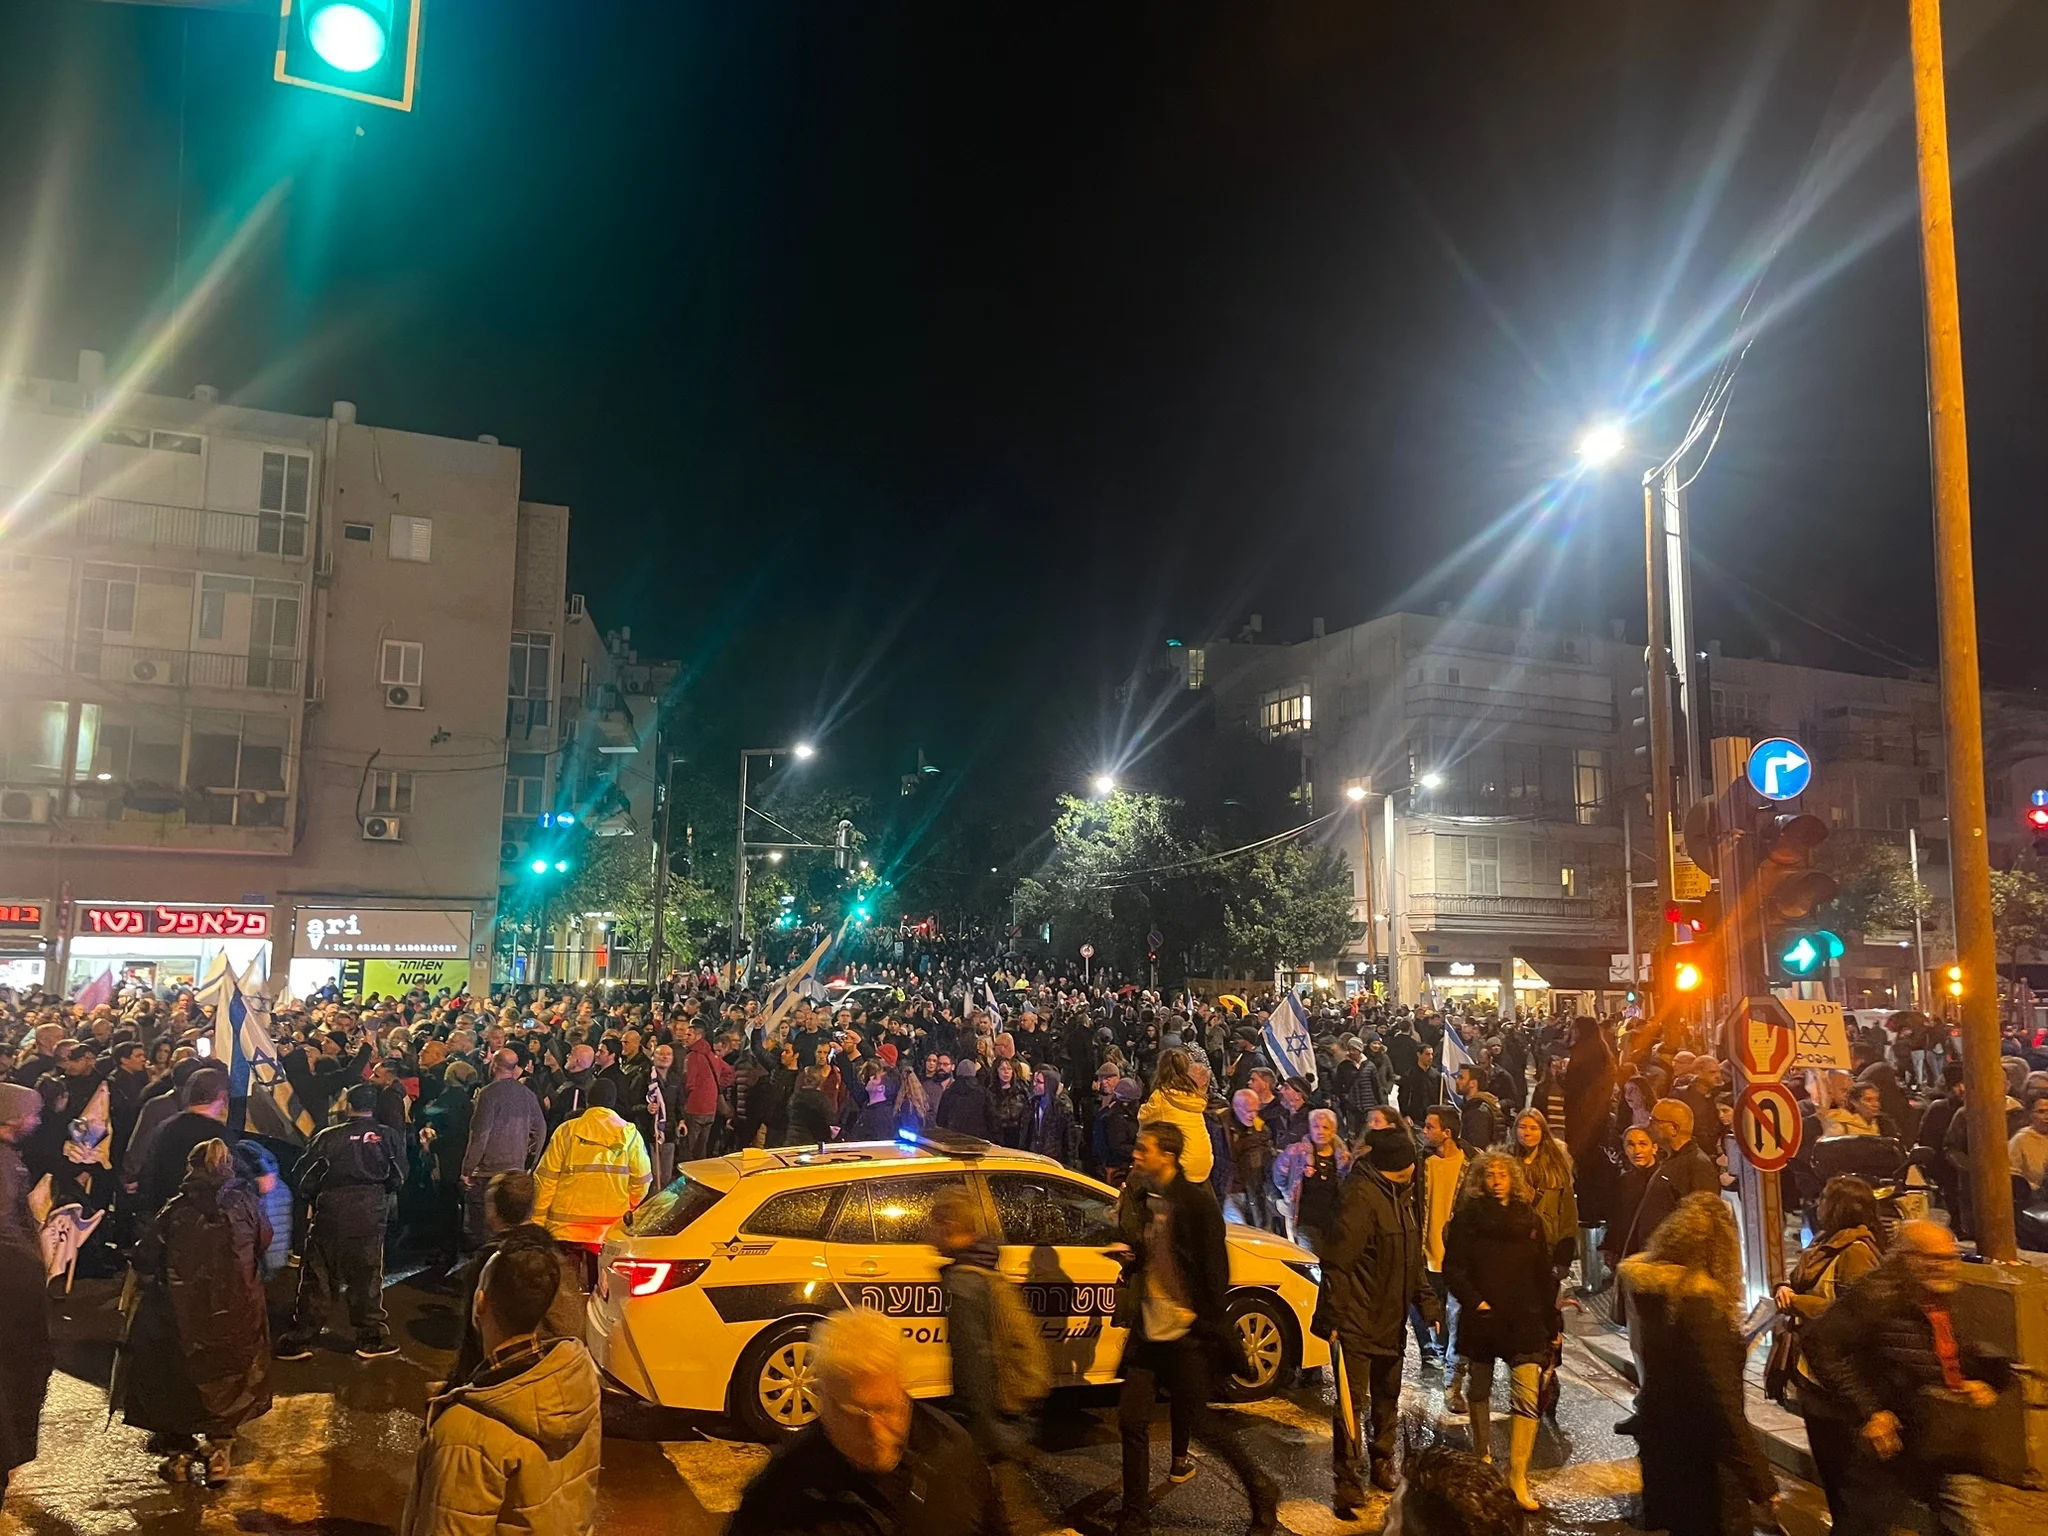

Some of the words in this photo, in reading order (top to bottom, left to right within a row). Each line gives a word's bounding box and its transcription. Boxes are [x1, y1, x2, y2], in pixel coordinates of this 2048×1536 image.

[88, 909, 144, 934] נטו
[156, 905, 267, 936] פלאפל
[306, 914, 361, 935] ari
[394, 944, 457, 952] LABORATORY
[397, 973, 443, 985] NOW
[861, 1286, 953, 1314] נועה
[1022, 1286, 1116, 1314] שטרת
[901, 1327, 951, 1344] POL
